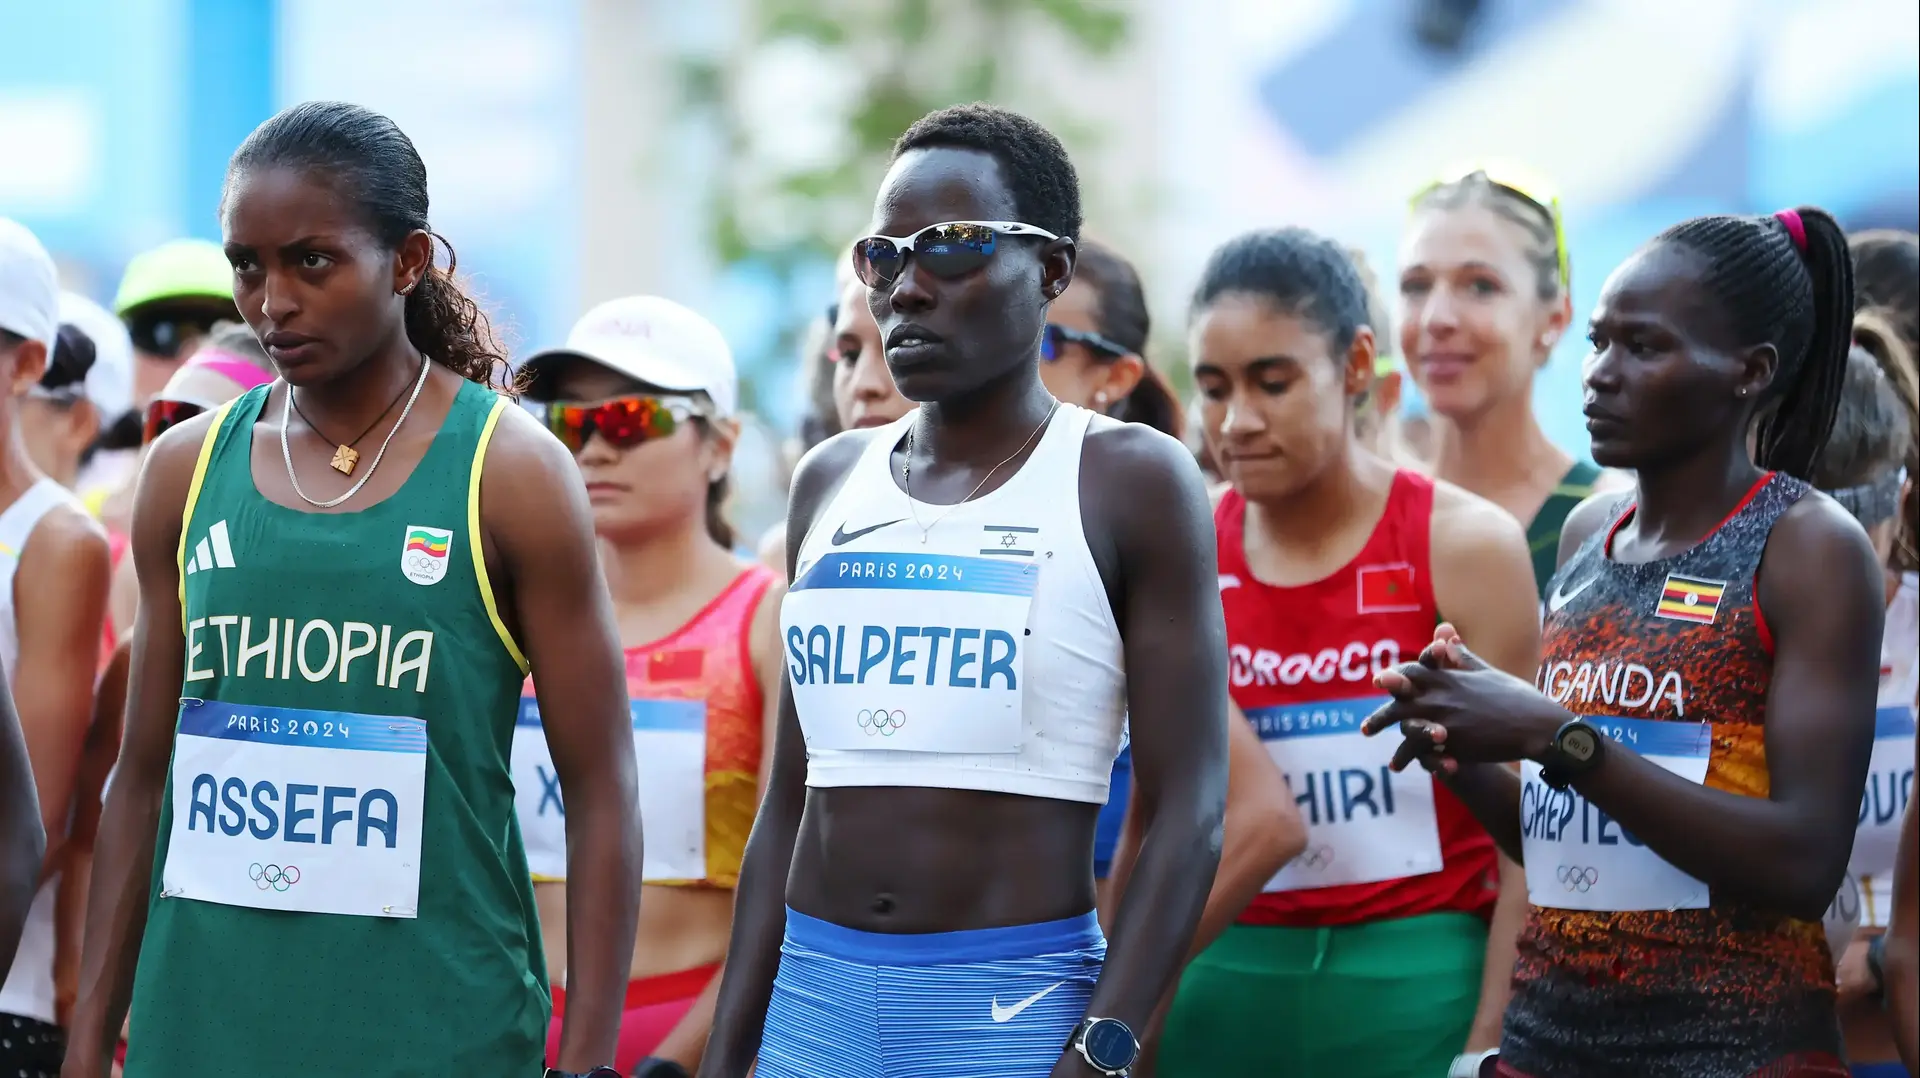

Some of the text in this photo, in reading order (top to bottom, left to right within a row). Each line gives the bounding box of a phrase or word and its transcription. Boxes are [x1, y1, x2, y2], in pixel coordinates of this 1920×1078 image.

[409, 571, 435, 581] ETHIOPIA
[905, 562, 964, 581] 2024
[186, 615, 434, 693] ETHIOPIA
[787, 624, 1017, 691] SALPETER
[1229, 638, 1400, 687] OROCCO
[1534, 660, 1684, 717] UGANDA
[288, 719, 349, 738] 2024
[187, 772, 399, 849] ASSEFA
[1283, 764, 1395, 826] HIRI
[1520, 781, 1645, 847] CHEPTE
